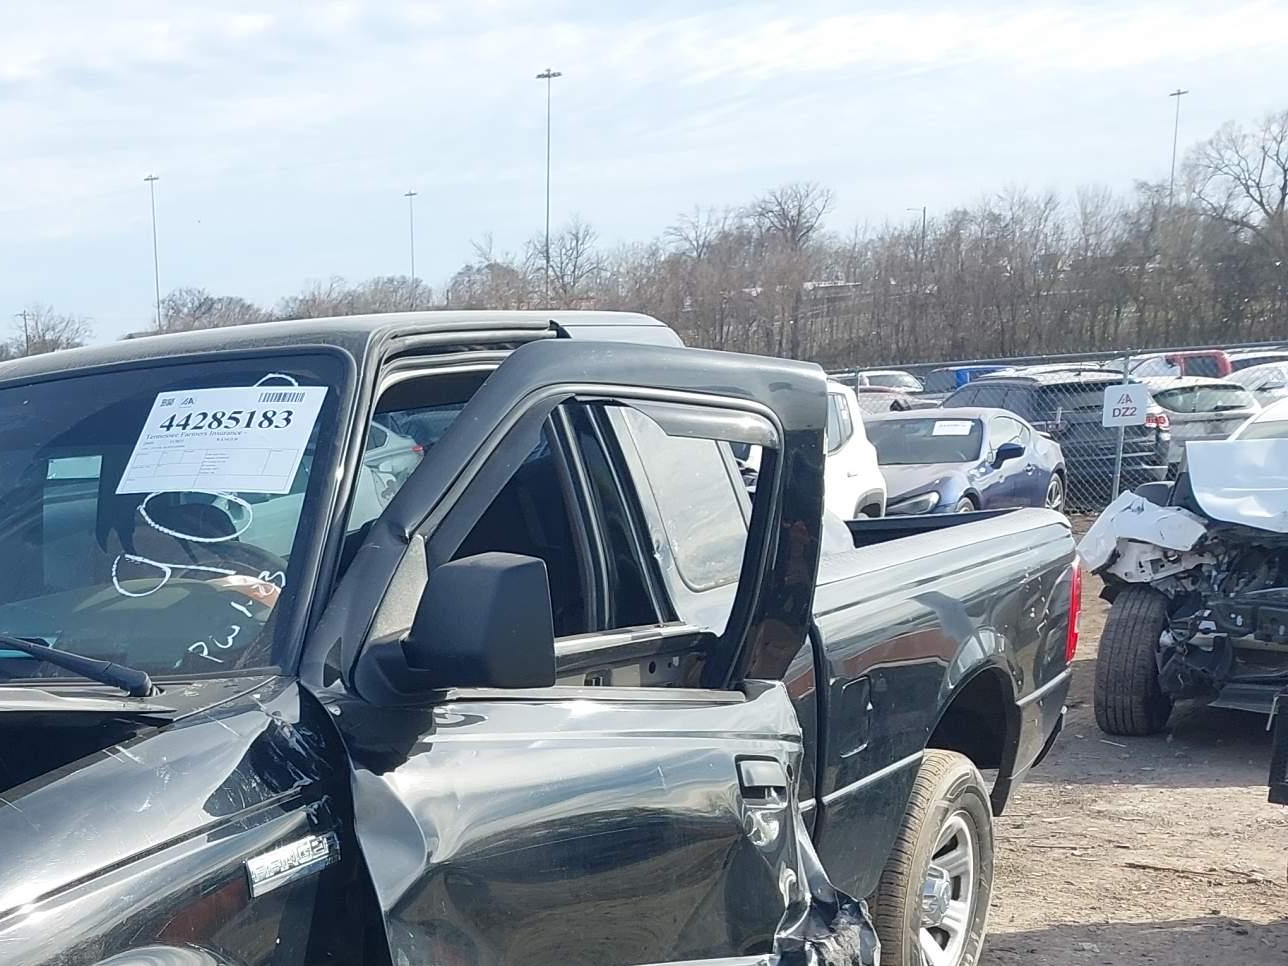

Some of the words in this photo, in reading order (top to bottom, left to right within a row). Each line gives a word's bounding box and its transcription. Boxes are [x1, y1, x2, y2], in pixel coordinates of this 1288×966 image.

[1112, 406, 1137, 418] DZ2
[159, 409, 294, 432] 44285183
[180, 430, 209, 438] Farmers
[210, 429, 242, 437] Insurance
